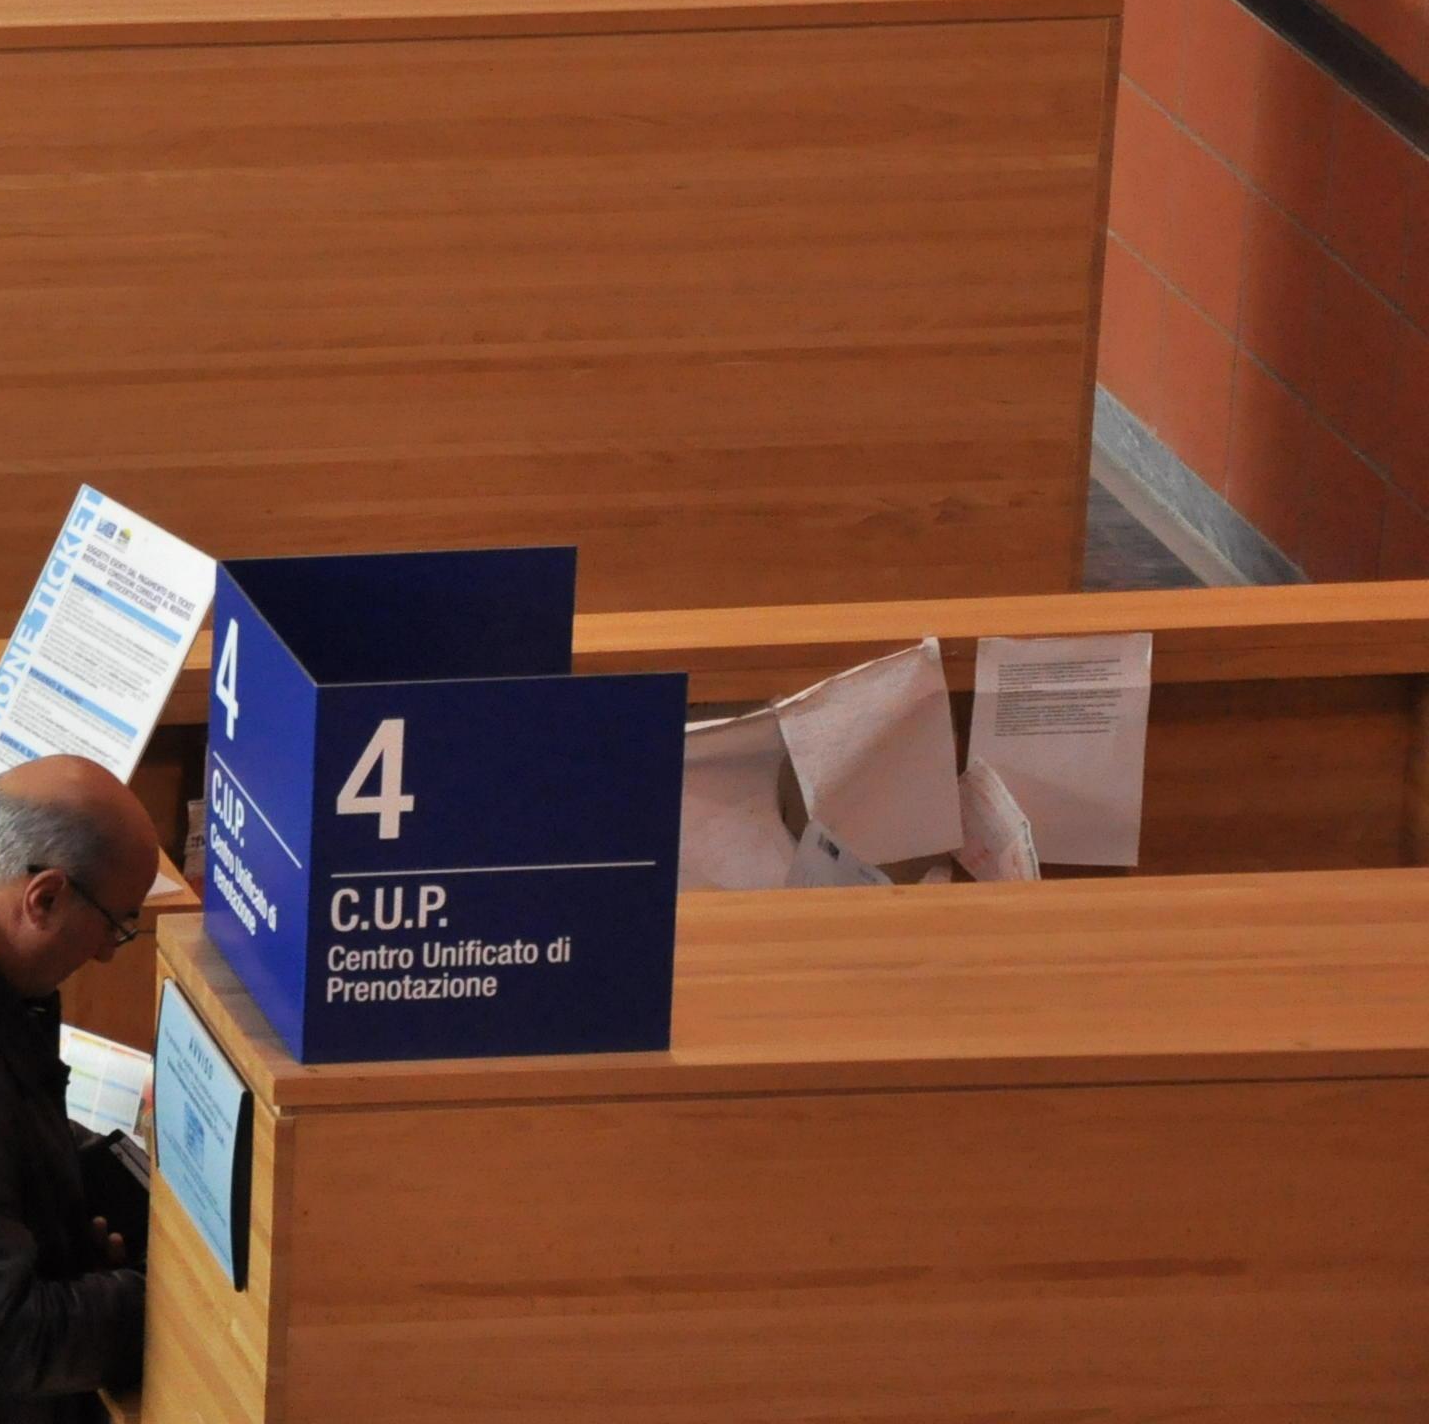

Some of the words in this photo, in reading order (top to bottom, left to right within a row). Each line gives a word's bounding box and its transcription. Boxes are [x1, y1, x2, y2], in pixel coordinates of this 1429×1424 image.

[28, 489, 102, 616] TICKET
[215, 618, 239, 740] 4
[212, 769, 244, 848] C.U.P.
[336, 718, 414, 840] 4
[268, 904, 277, 933] di
[330, 885, 448, 932] C.U.P.
[328, 945, 414, 972] Centro
[422, 939, 539, 967] Unificato
[546, 937, 571, 964] di
[326, 972, 498, 1003] Prenotazione
